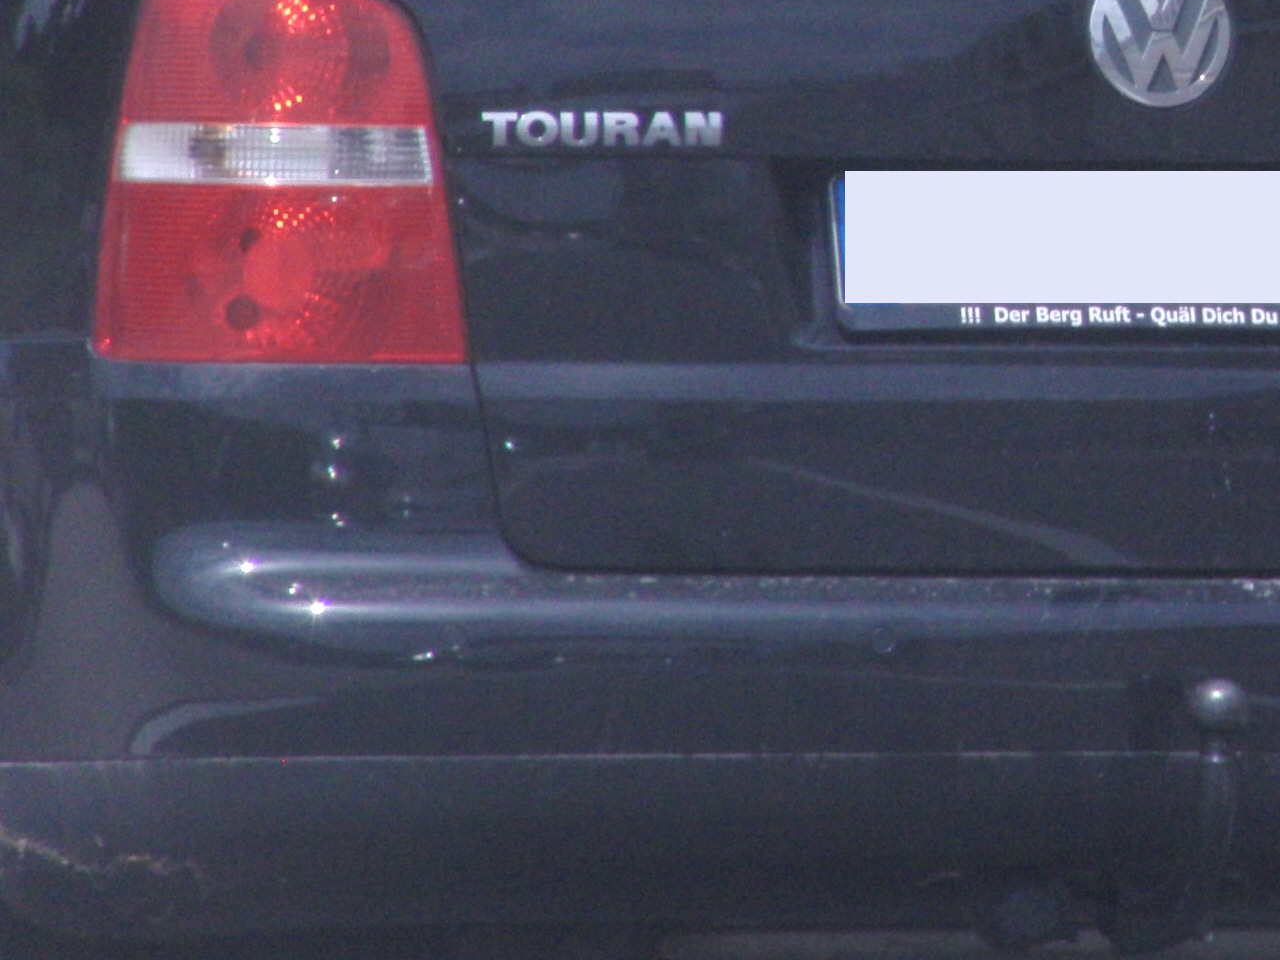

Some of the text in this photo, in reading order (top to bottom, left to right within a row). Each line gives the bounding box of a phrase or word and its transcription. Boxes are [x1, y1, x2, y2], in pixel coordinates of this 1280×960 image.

[480, 110, 723, 147] TOURAN
[994, 306, 1030, 324] Der
[1036, 306, 1083, 326] Berg
[1088, 306, 1131, 323] Ruft
[1150, 306, 1196, 326] Quäl
[1202, 307, 1245, 324] Dich
[1250, 308, 1279, 326] Du
